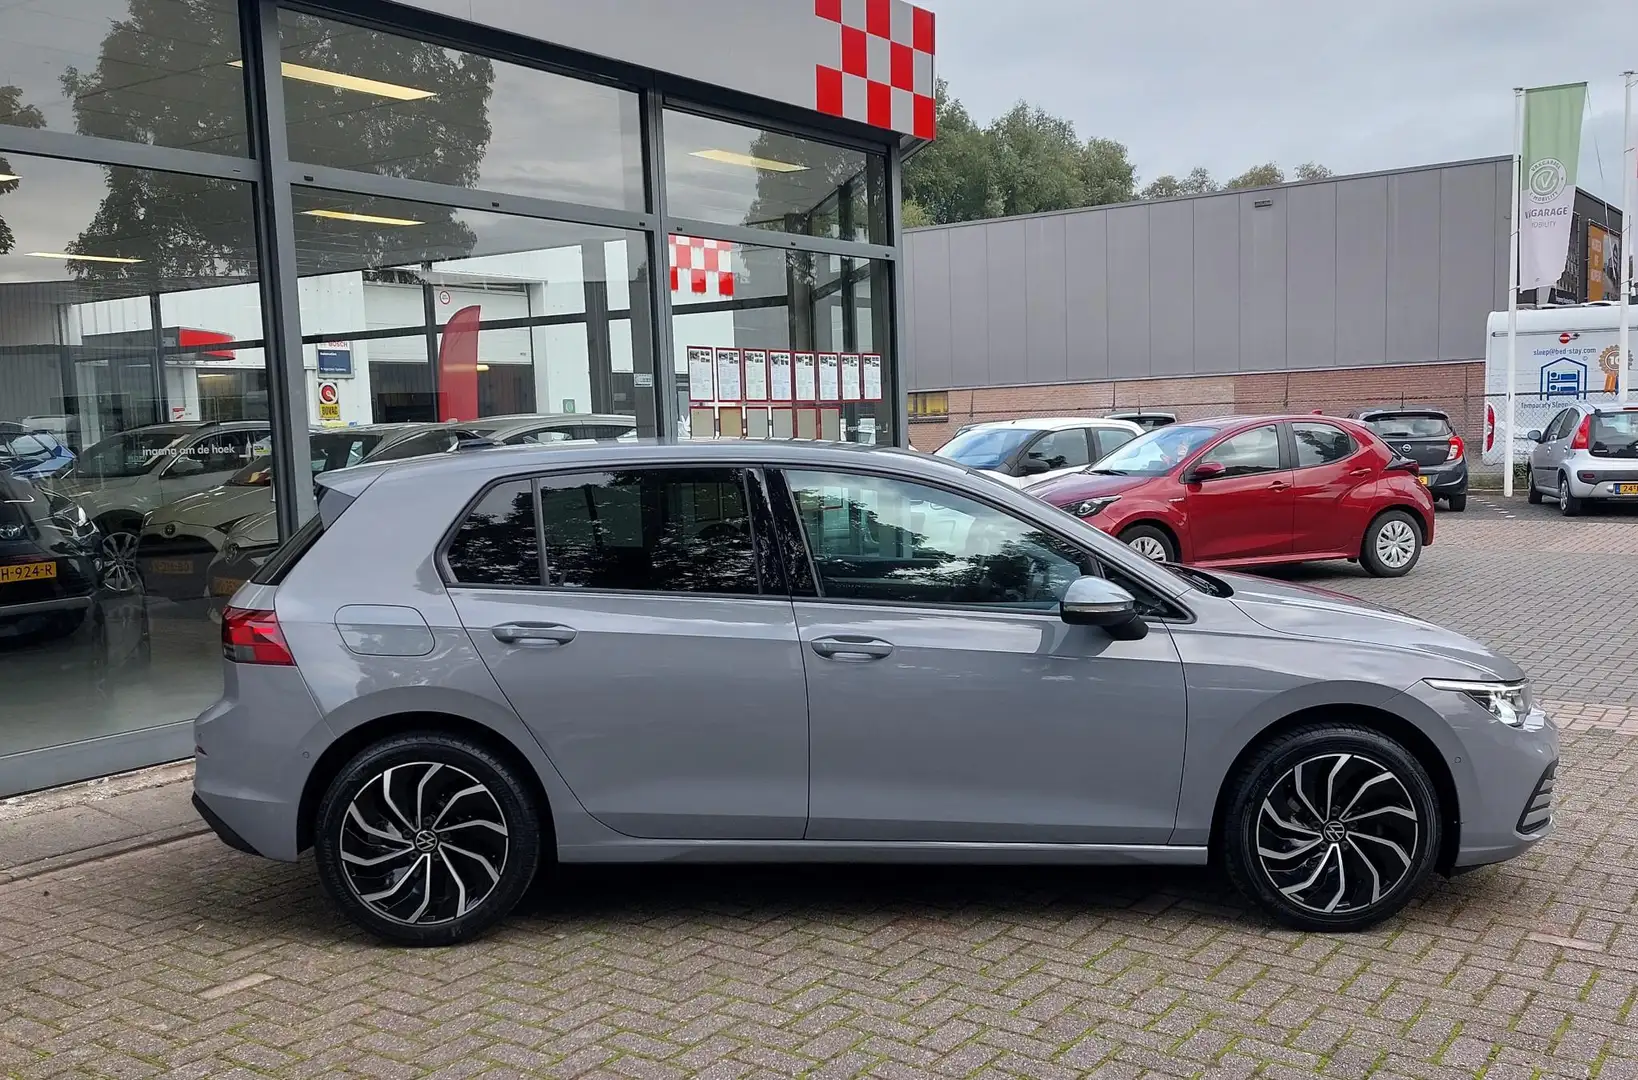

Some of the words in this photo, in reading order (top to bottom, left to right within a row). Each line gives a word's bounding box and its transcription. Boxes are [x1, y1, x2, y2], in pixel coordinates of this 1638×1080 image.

[142, 446, 177, 457] ingang
[180, 447, 195, 455] om
[197, 444, 210, 454] de
[211, 443, 235, 454] hoek
[1, 564, 53, 581] H-924-R
